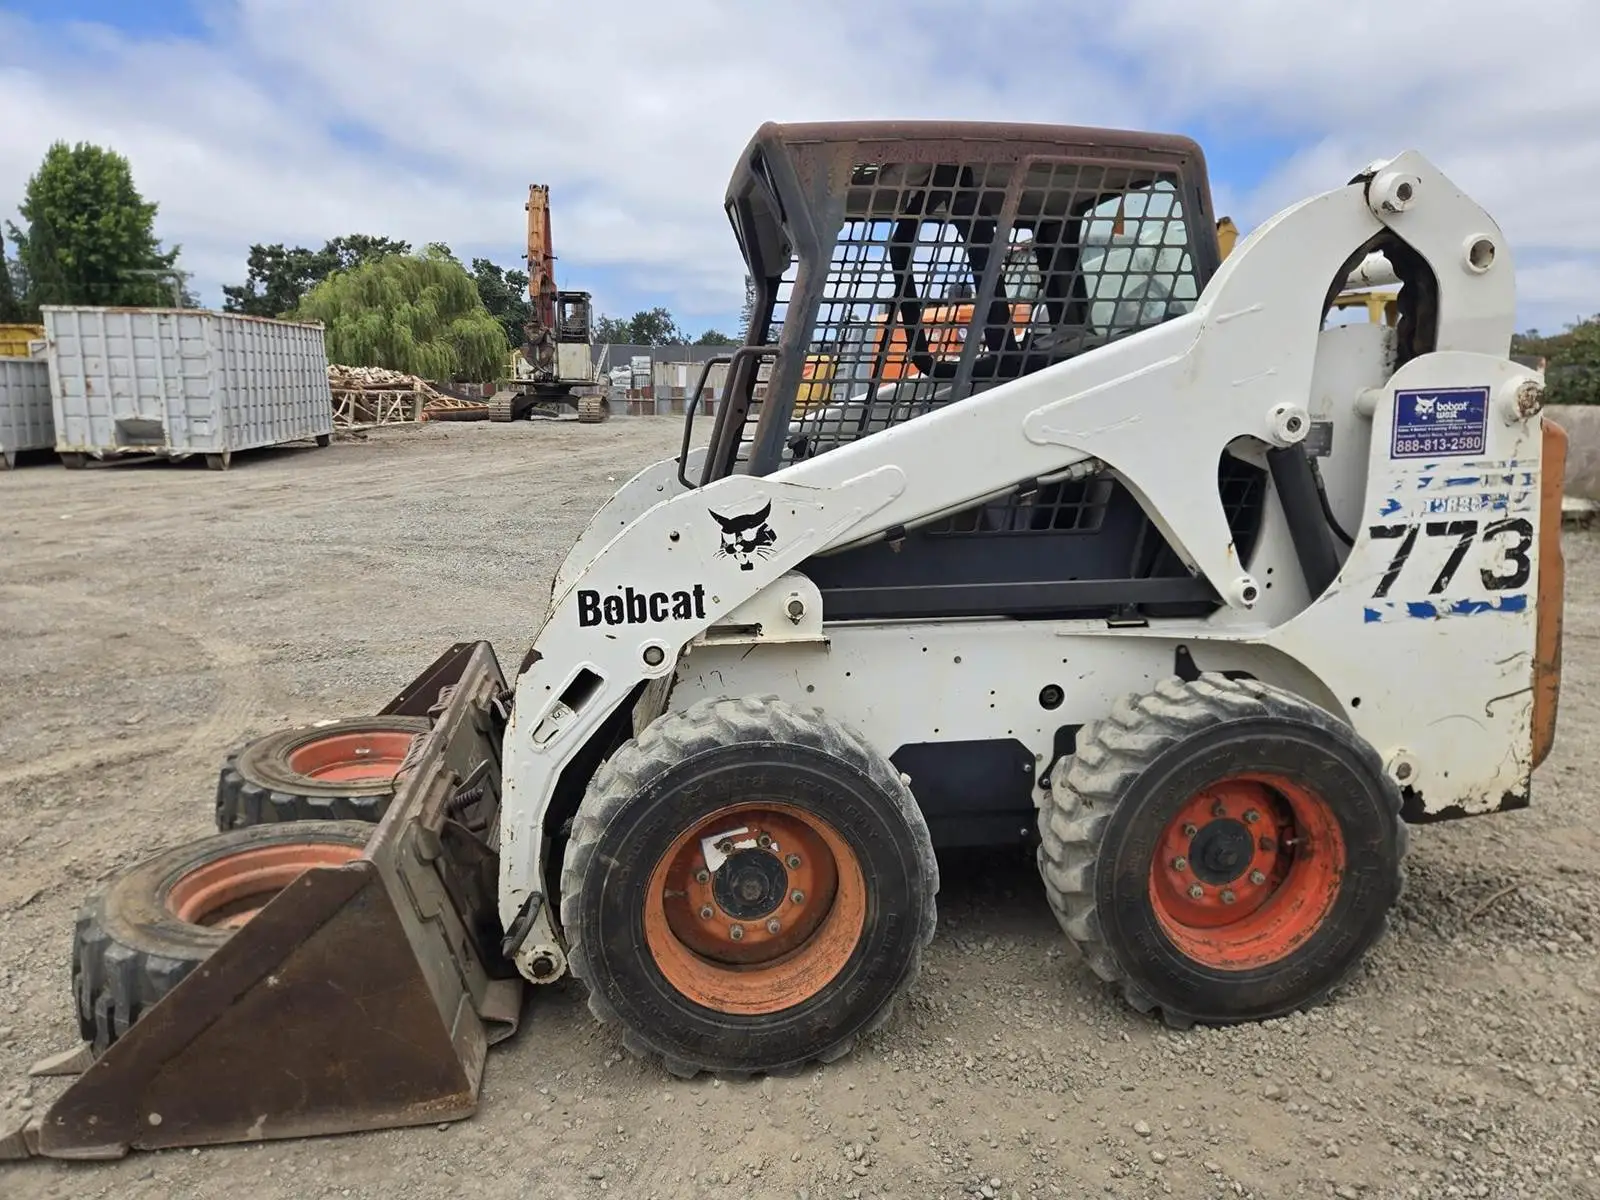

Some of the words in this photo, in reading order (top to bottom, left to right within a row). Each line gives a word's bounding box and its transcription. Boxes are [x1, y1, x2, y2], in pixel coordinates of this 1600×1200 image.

[1436, 401, 1467, 411] bobcat
[1396, 436, 1481, 453] 888-813-2580
[1368, 517, 1533, 599] 773
[577, 584, 706, 627] Bobcat
